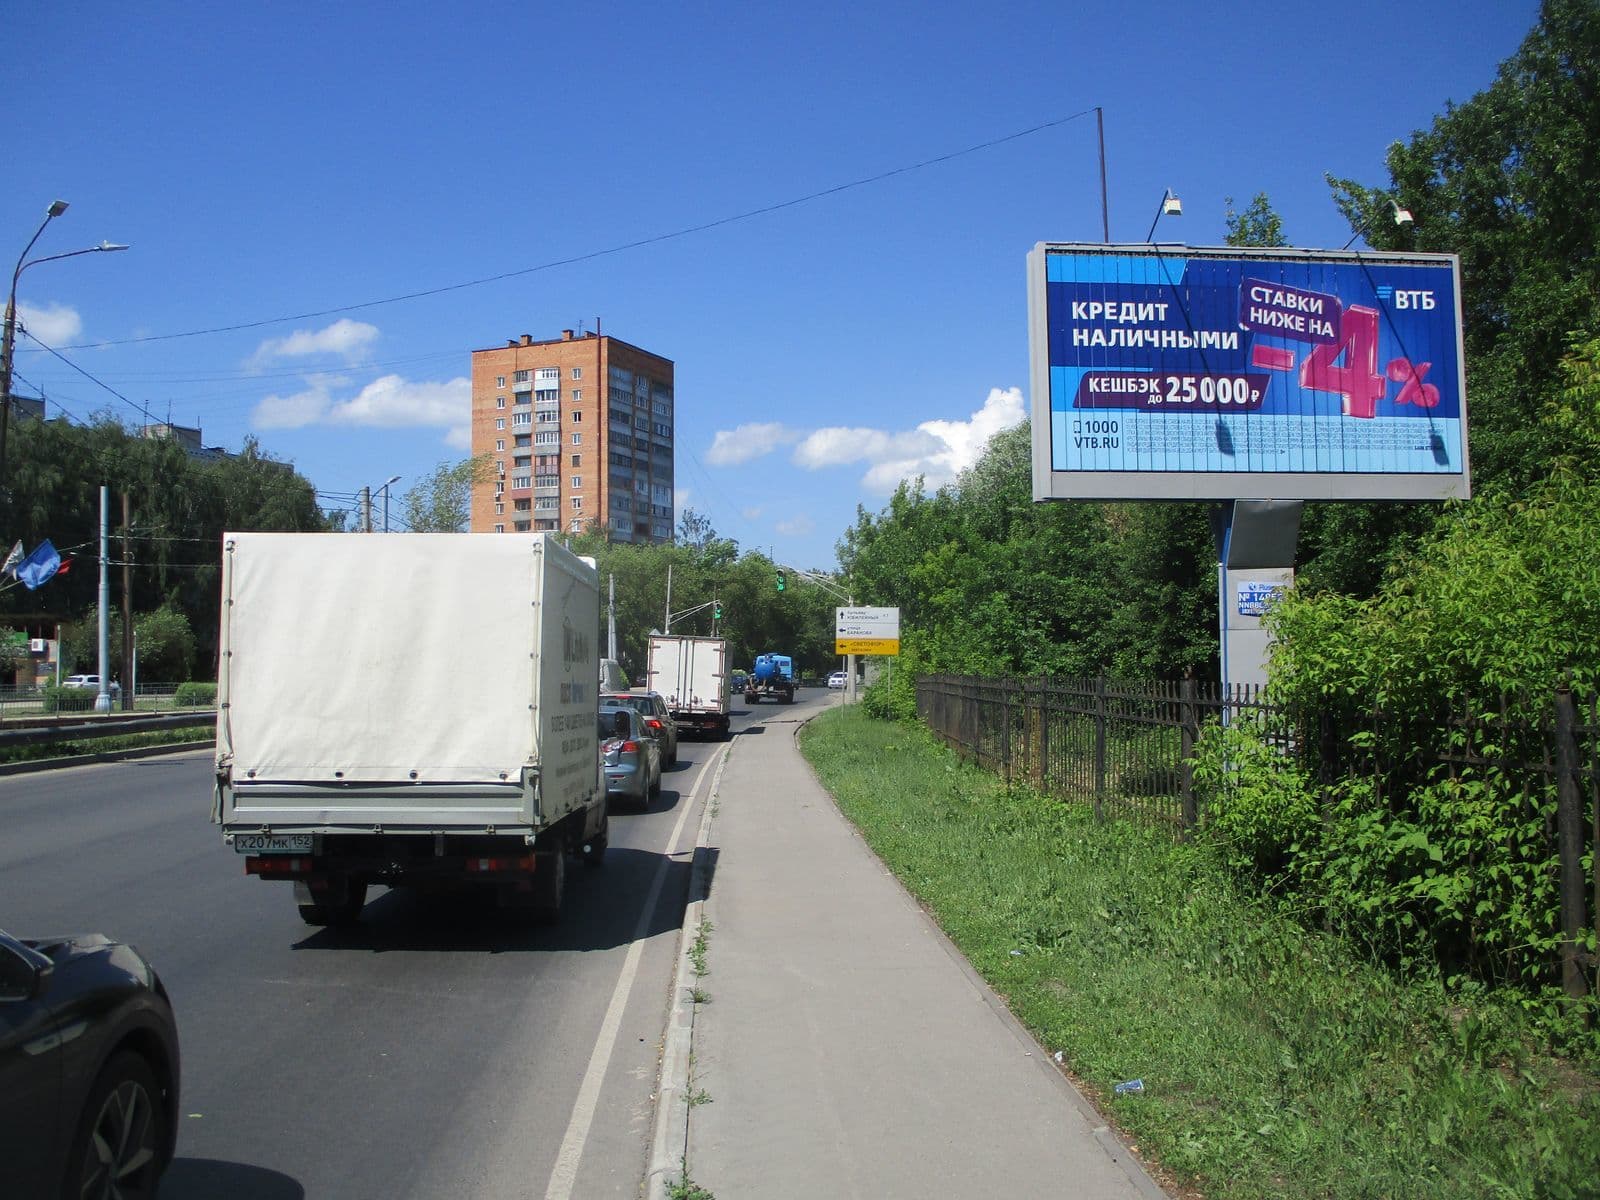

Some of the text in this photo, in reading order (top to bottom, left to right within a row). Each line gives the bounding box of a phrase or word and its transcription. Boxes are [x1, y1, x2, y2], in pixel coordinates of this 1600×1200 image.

[1250, 286, 1323, 315] СТАВКИ
[1395, 290, 1435, 310] ВТБ
[1071, 301, 1168, 324] КРЕДИТ
[1250, 307, 1335, 338] НИЖЕ НА
[1072, 328, 1239, 350] НАЛИЧНЫМИ
[1088, 377, 1160, 394] КЕШБЭК
[1085, 420, 1119, 435] 1000
[1074, 436, 1120, 450] VTB.RU
